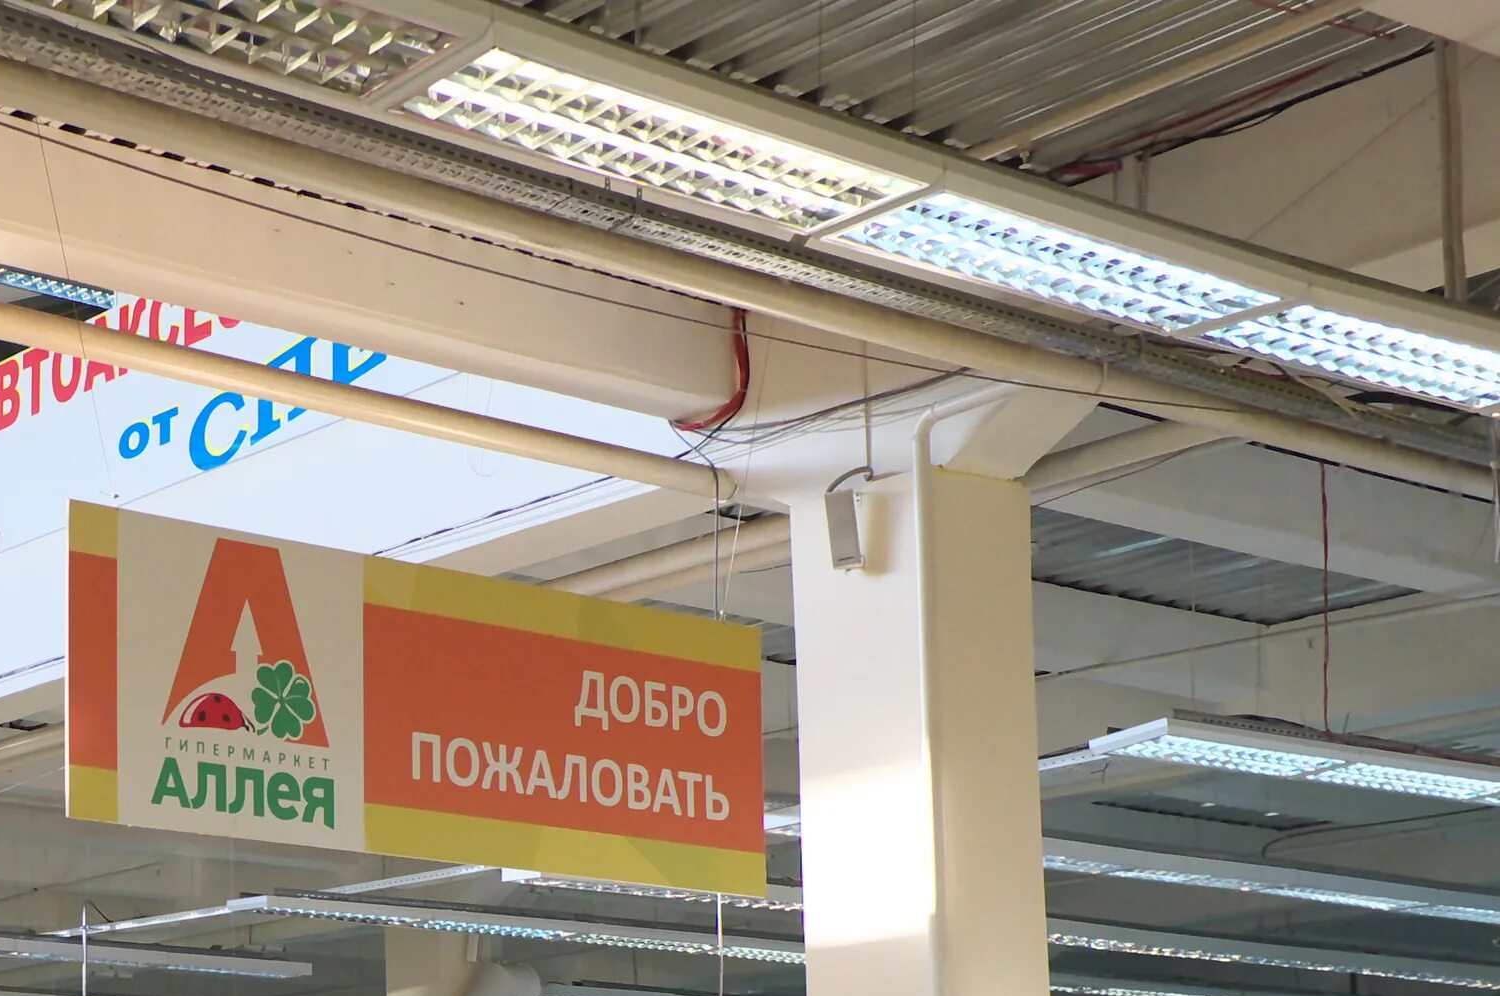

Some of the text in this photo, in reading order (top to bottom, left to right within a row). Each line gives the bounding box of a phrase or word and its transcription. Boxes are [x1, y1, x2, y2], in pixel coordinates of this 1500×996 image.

[574, 669, 727, 737] ДОБРО
[165, 736, 331, 771] ГИПЕРМАРКЕТ
[411, 731, 730, 821] ПОЖАЛОВАТЬ
